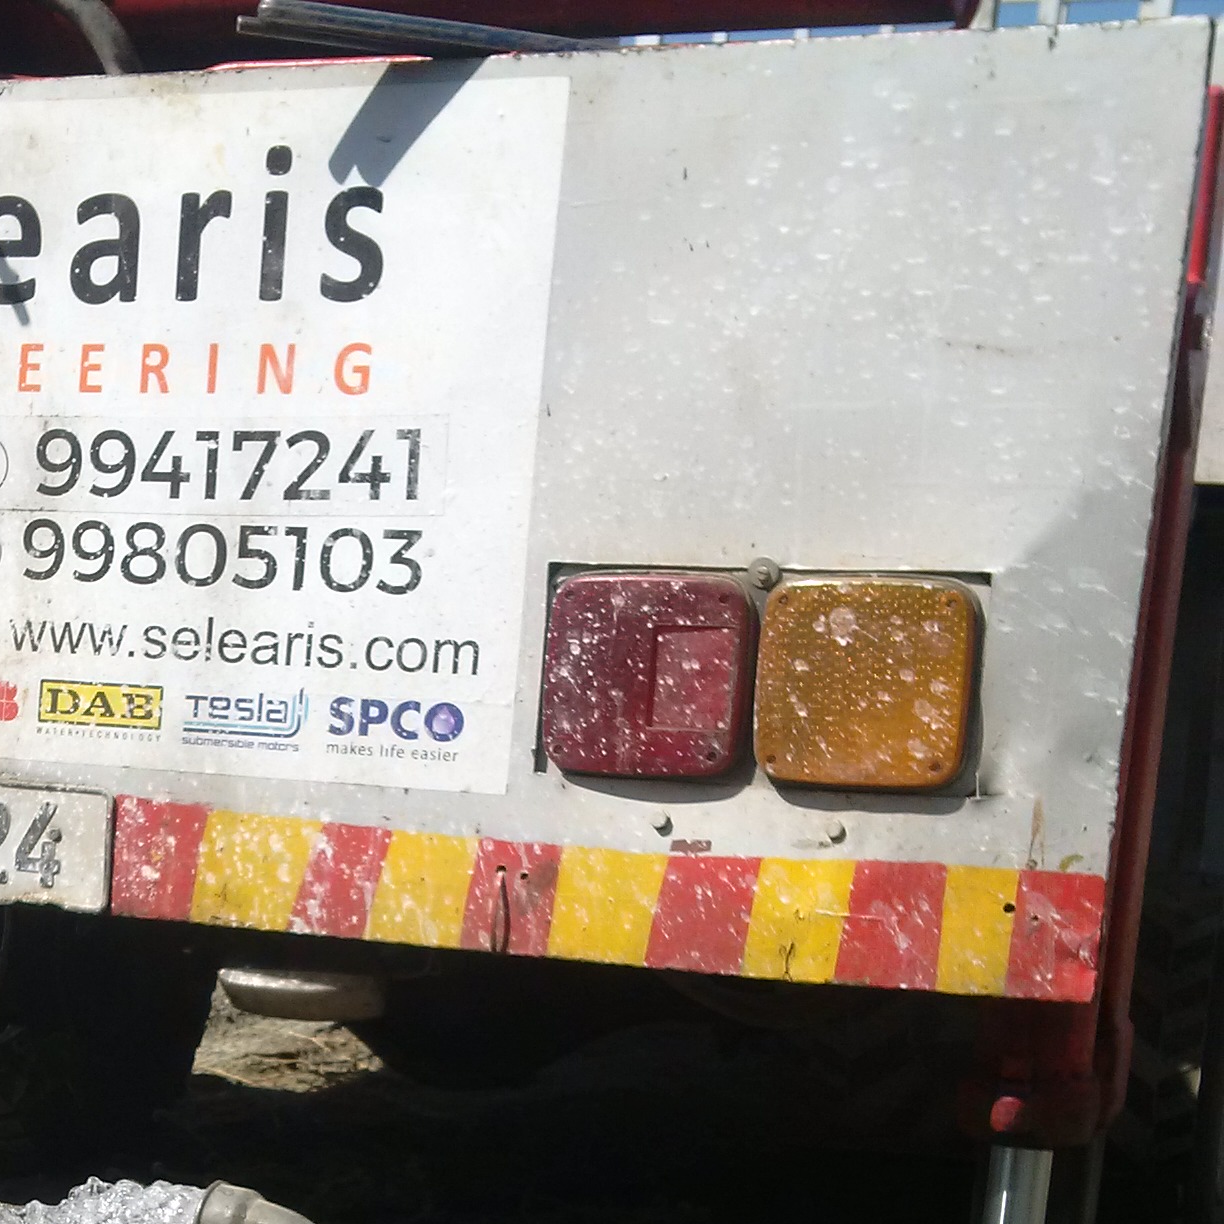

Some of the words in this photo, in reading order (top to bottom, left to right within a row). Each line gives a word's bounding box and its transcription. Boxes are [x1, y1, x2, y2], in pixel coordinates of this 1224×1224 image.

[35, 428, 423, 501] 99417241
[22, 518, 424, 596] 99805103
[9, 616, 480, 676] www.selearis.com
[45, 687, 155, 720] DAB
[327, 696, 465, 742] SPCO
[181, 736, 255, 749] submersible
[257, 740, 299, 752] motors
[326, 742, 373, 757] makes
[379, 743, 405, 759] life
[410, 749, 459, 763] easier
